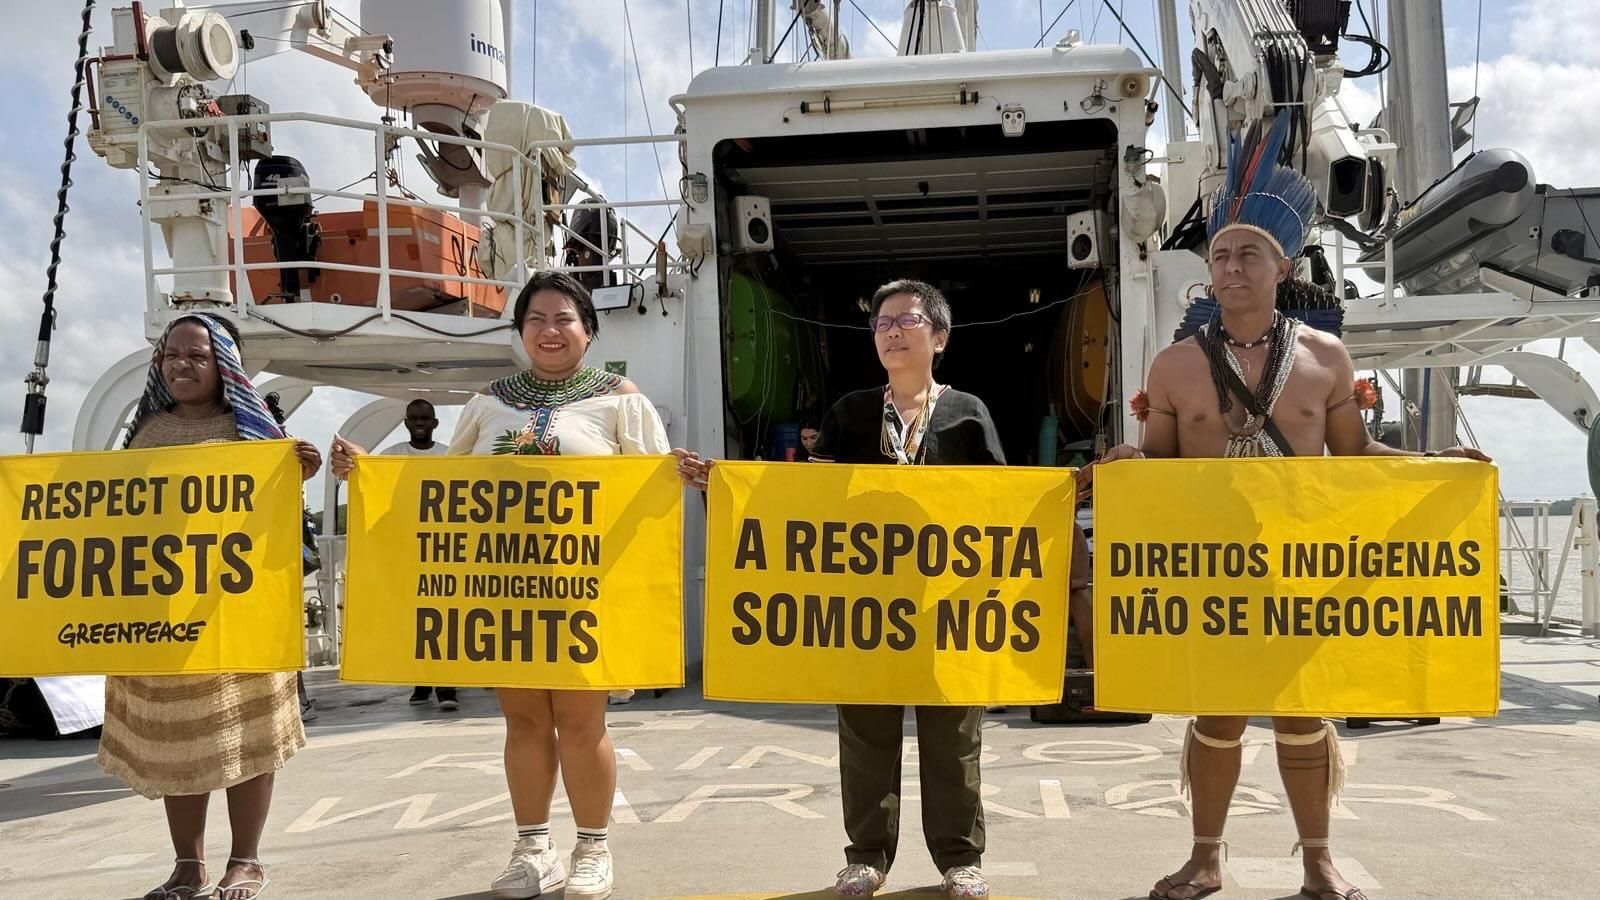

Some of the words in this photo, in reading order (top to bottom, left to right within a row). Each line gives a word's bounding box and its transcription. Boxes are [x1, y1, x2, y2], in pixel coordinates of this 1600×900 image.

[21, 476, 169, 521] RESPECT
[180, 474, 255, 515] OUR
[419, 479, 600, 525] RESPECT
[16, 532, 254, 600] FORESTS
[416, 531, 468, 563] THE
[474, 532, 600, 566] AMAZON
[734, 518, 768, 571] A
[785, 520, 1043, 579] RESPOSTA
[1110, 542, 1269, 578] DIREITOS
[1282, 535, 1481, 578] INDÍGENAS
[416, 573, 457, 597] AND
[464, 574, 599, 600] INDIGENOUS
[57, 620, 207, 649] GREENPEACE
[415, 607, 599, 664] RIGHTS
[731, 591, 917, 652] SOMOS
[936, 589, 1041, 653] NÓS
[1110, 587, 1189, 636] NÃO
[1202, 595, 1249, 636] SE
[1263, 596, 1482, 637] NEGOCIAM
